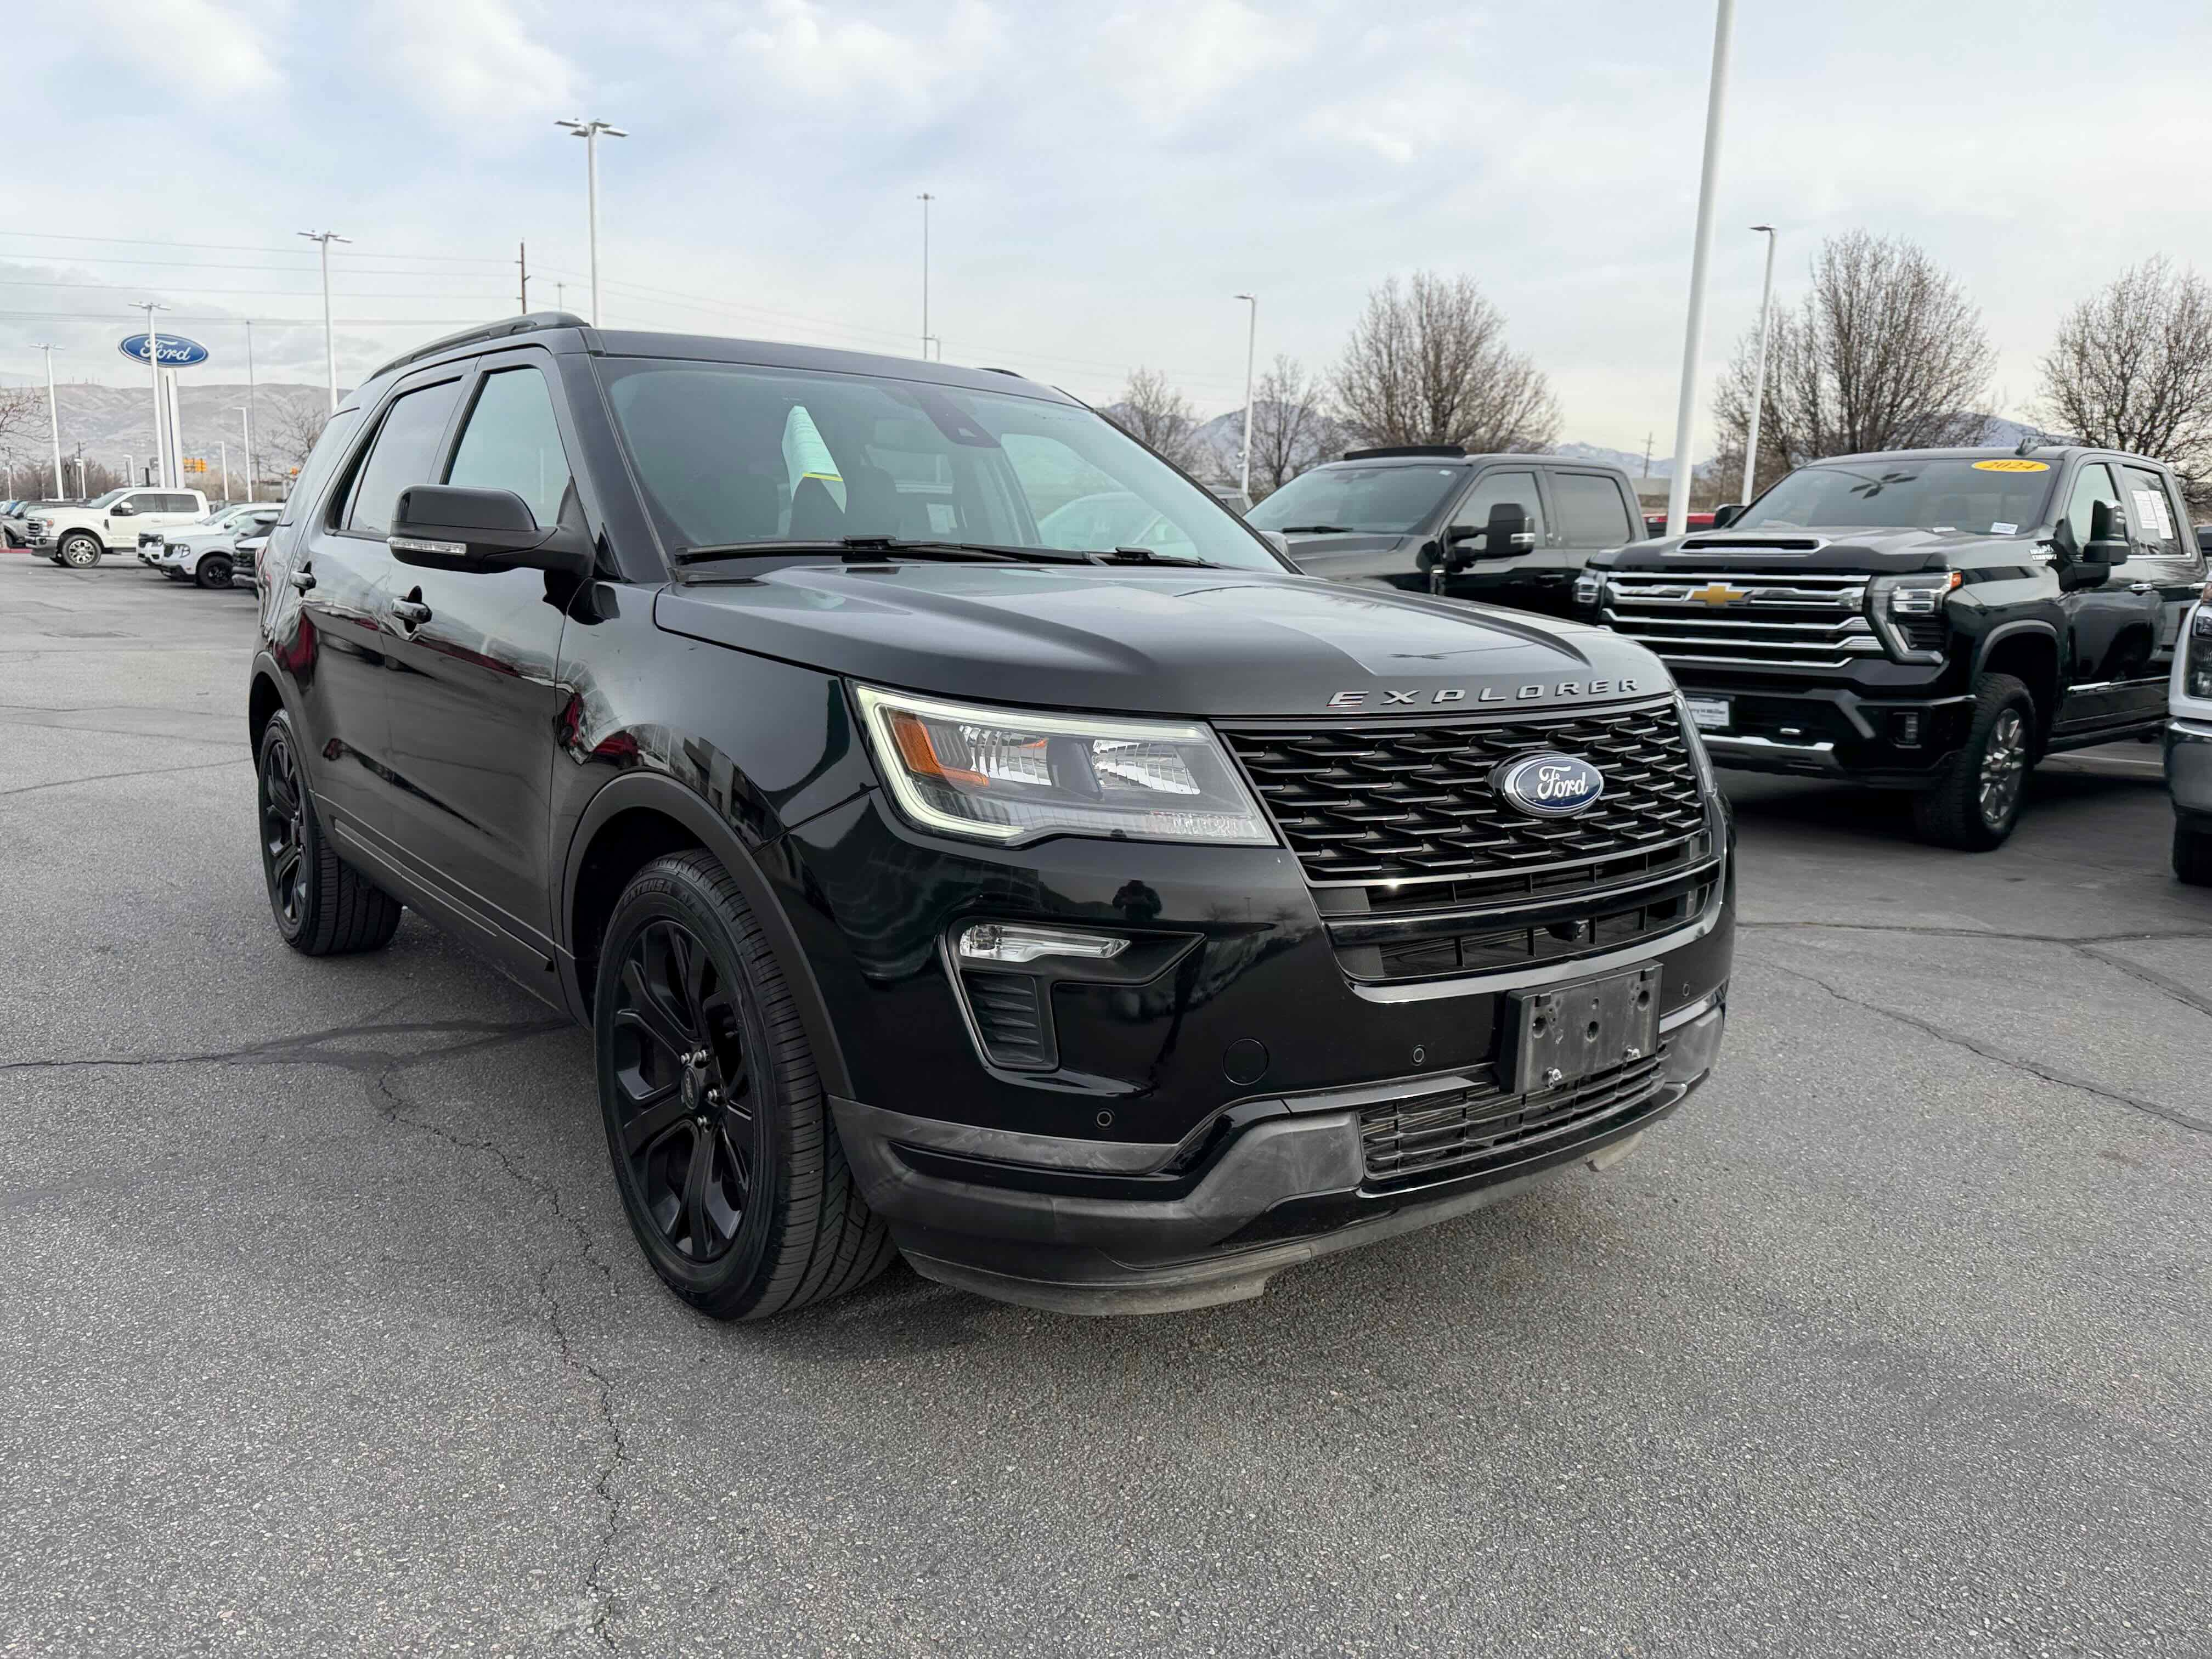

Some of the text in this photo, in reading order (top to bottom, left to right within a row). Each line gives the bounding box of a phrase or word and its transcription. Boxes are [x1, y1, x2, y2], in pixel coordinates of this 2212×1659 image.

[140, 338, 191, 360] Ford
[1327, 678, 1639, 707] EXPLORER
[1537, 766, 1589, 799] Ford
